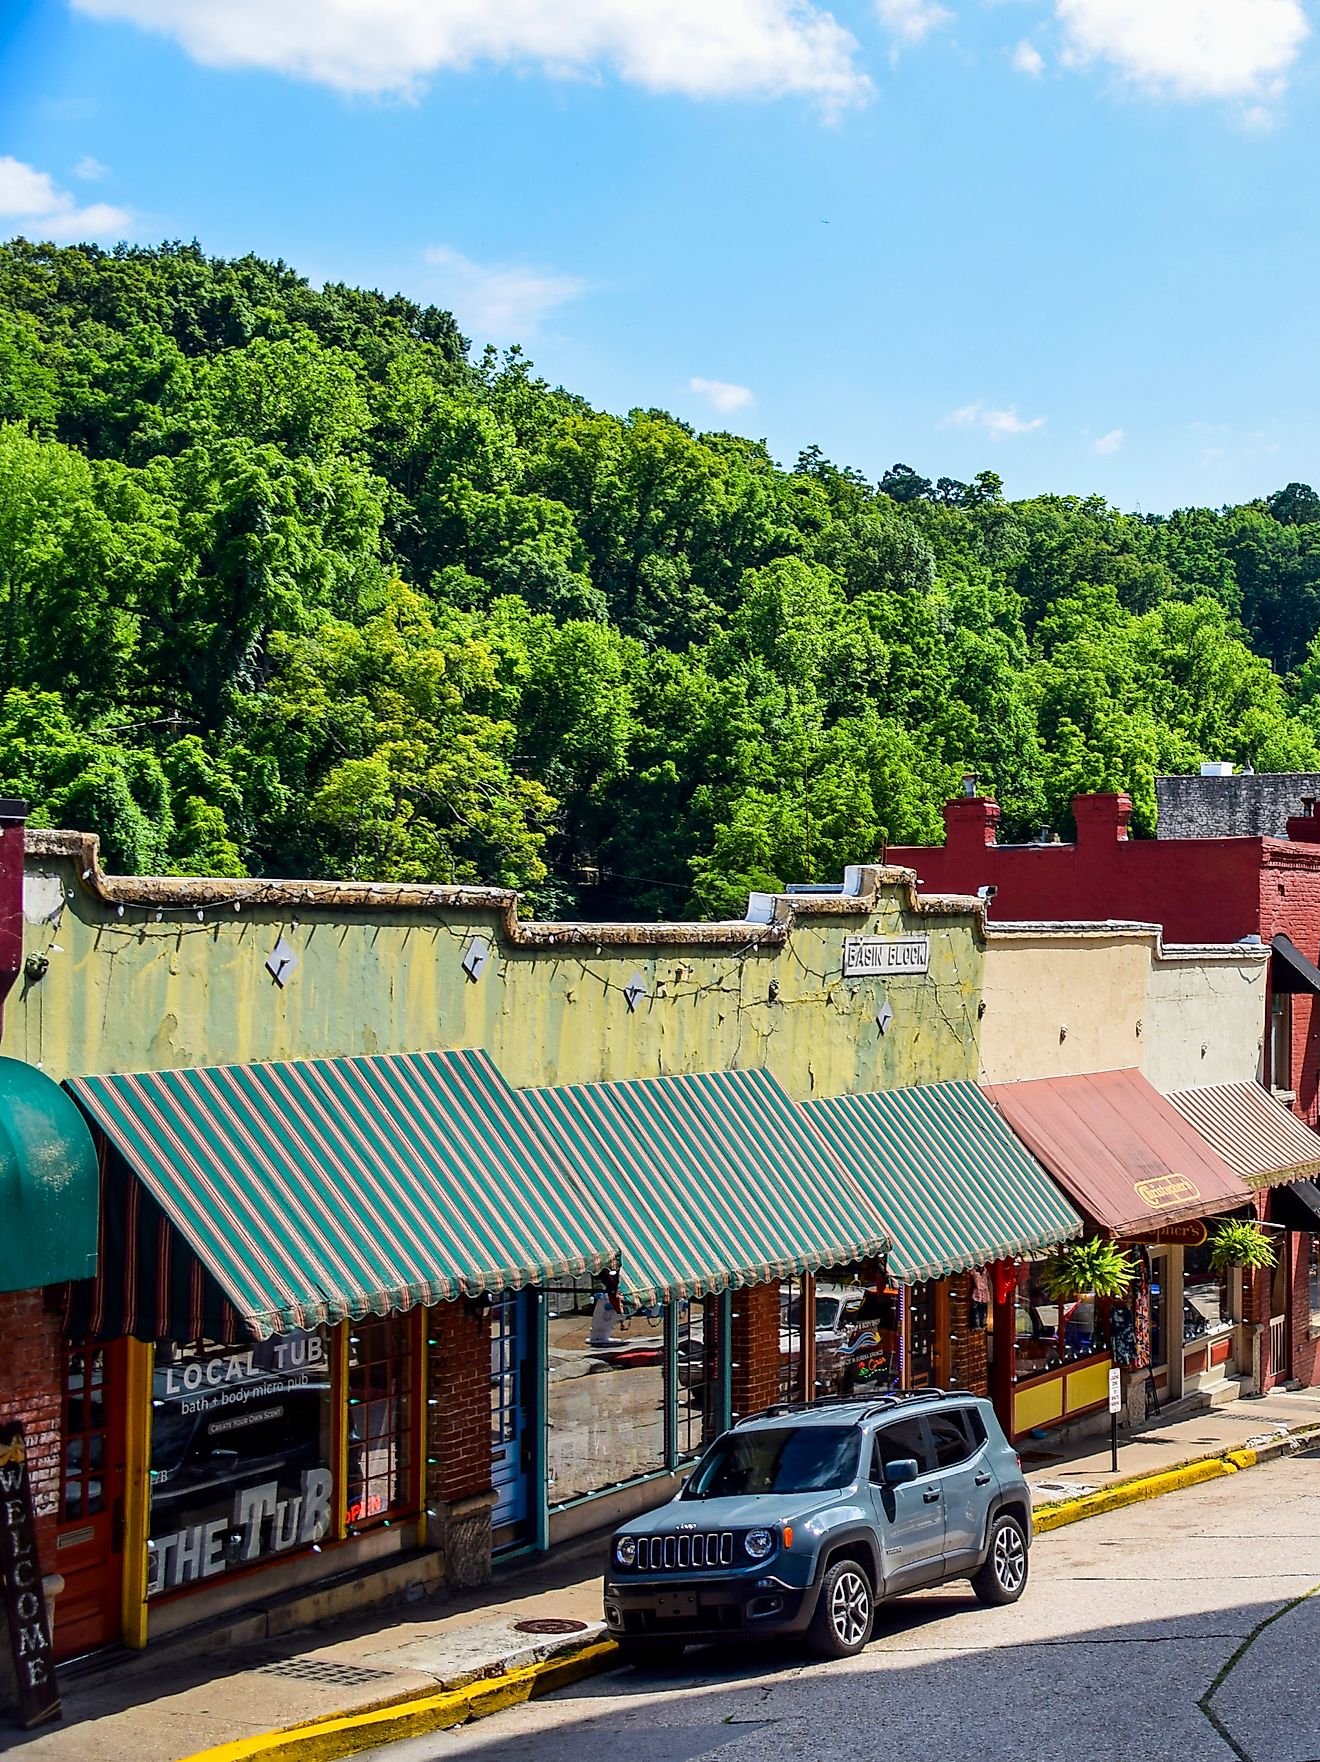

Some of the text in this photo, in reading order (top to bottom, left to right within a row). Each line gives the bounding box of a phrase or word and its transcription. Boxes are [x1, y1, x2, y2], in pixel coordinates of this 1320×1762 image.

[847, 945, 927, 967] BASIN BLOCK
[166, 1336, 325, 1395] LOCAL TUB
[181, 1396, 209, 1415] bath
[221, 1388, 250, 1406] body
[252, 1381, 285, 1398] micro
[287, 1375, 309, 1394] pub
[0, 1464, 49, 1688] WELCOME
[149, 1518, 228, 1595] THE
